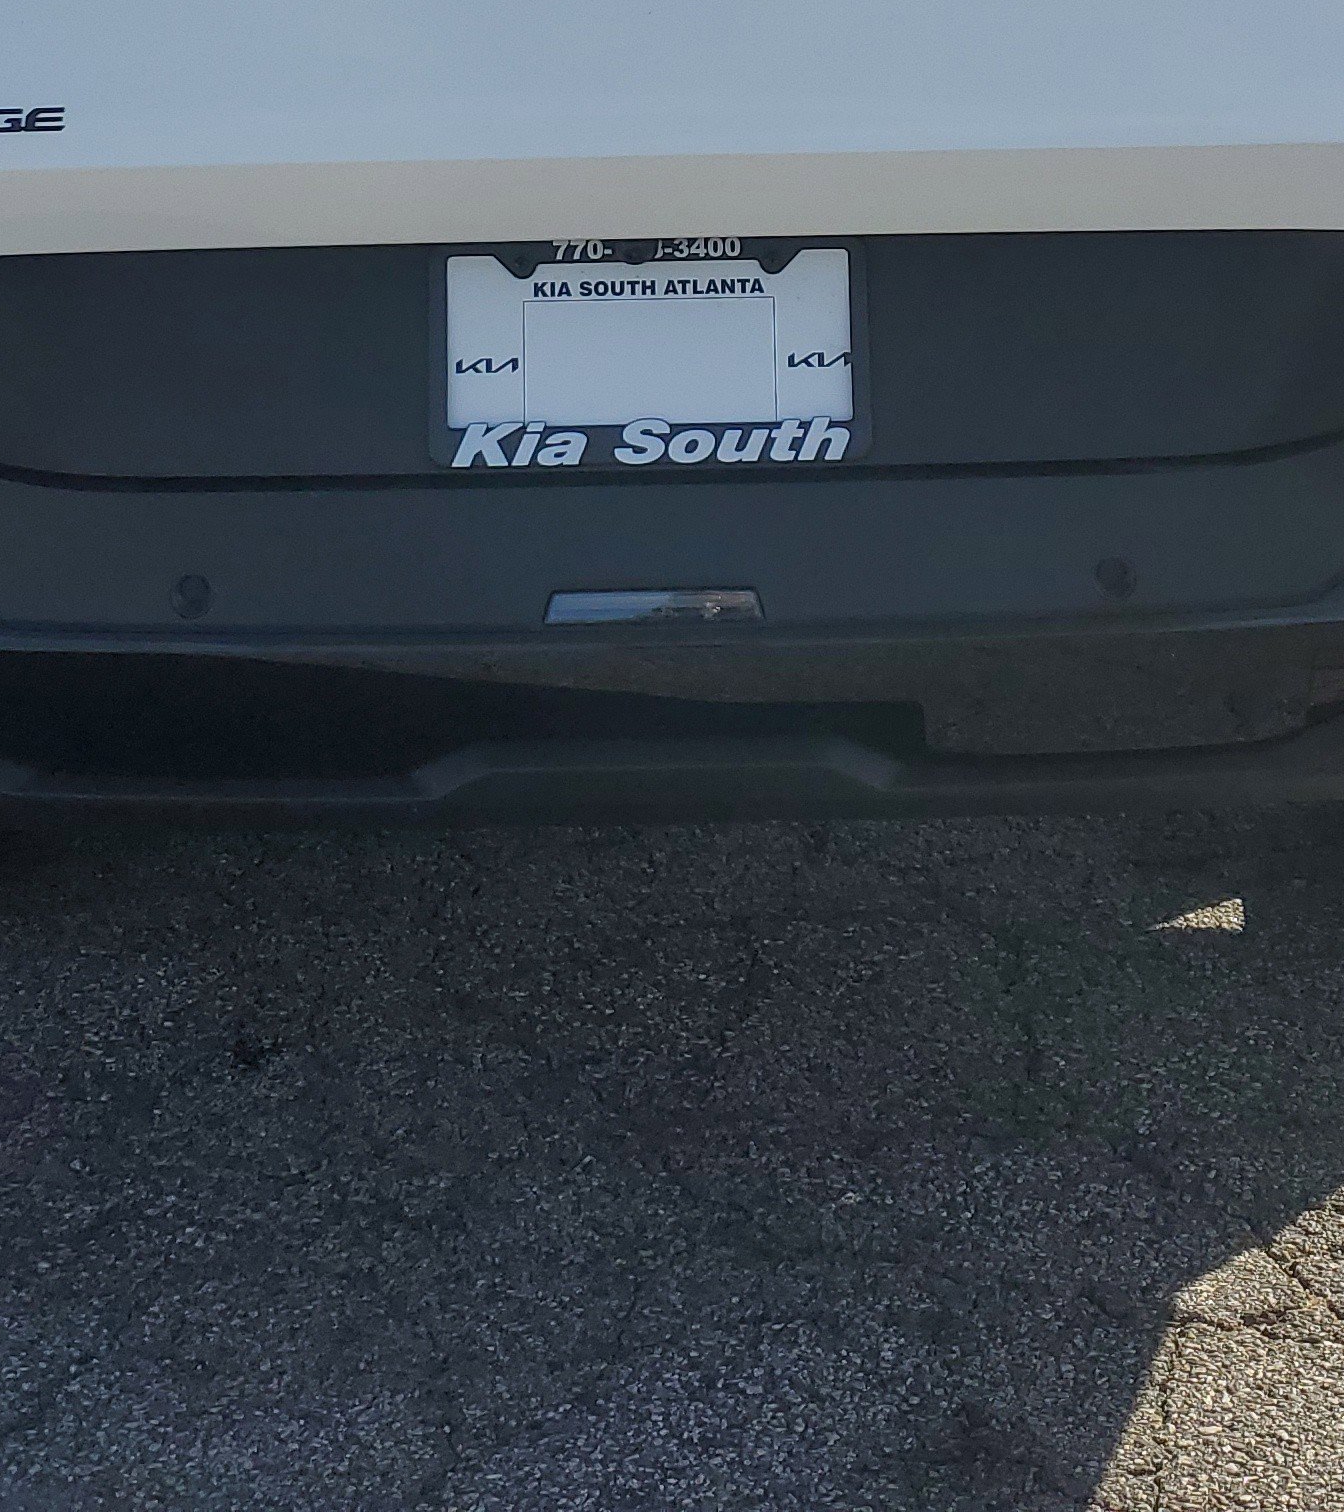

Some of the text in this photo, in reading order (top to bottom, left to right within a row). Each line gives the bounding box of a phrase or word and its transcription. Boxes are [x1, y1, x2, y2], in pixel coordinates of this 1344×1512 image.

[533, 277, 765, 298] KIA SOUTH ATLANTA
[455, 357, 519, 374] KIA
[787, 351, 852, 368] KIA
[450, 415, 851, 468] Kia South
